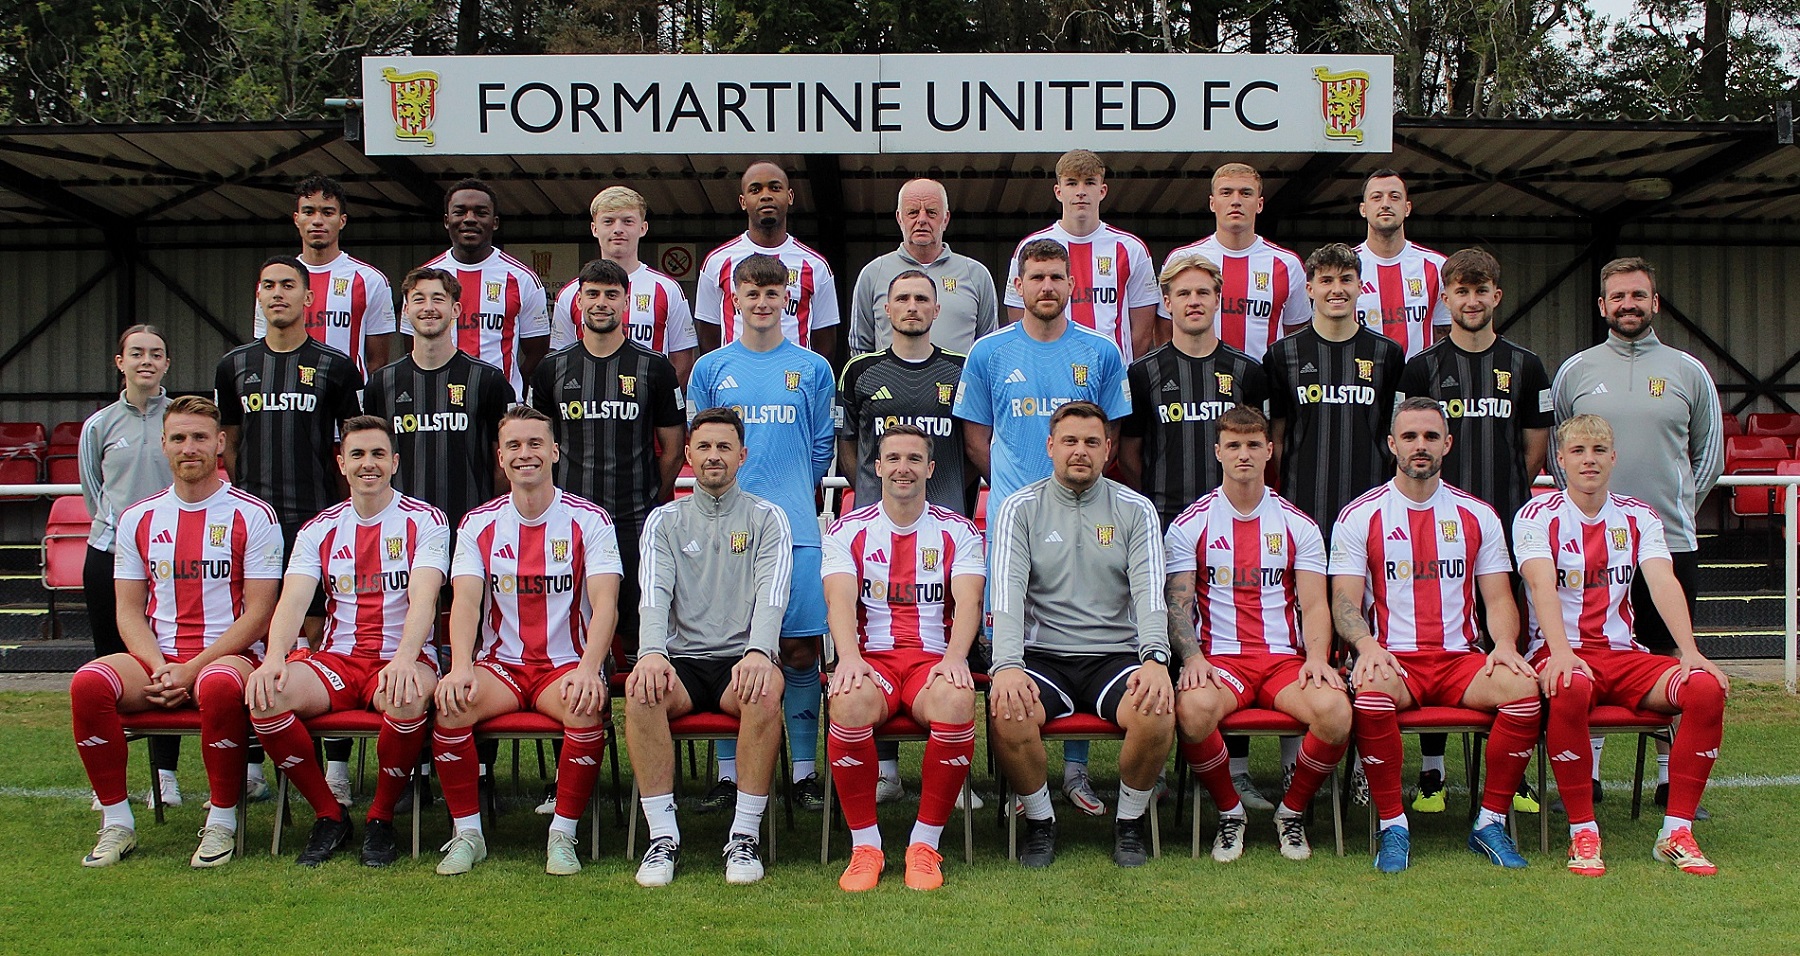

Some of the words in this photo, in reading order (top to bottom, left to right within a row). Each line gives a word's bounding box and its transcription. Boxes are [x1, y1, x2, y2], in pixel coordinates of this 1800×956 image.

[478, 81, 902, 133] FORMARTINE
[926, 81, 1177, 132] UNITED
[1203, 80, 1280, 131] FC
[1070, 287, 1117, 304] LLSTUD
[1221, 297, 1271, 317] LLSTUD
[456, 312, 504, 330] LLSTUD
[241, 392, 317, 413] ROLLSTUD
[1297, 384, 1375, 405] ROLLSTUD
[558, 400, 640, 420] ROLLSTUD
[1011, 397, 1084, 417] ROLLS
[1438, 398, 1512, 419] ROLLSTUD
[393, 412, 469, 434] ROLLSTUD
[150, 559, 231, 580] ROLLSTUD
[1207, 565, 1286, 587] ROLLSTUD
[1387, 558, 1464, 581] ROLLSTUD
[1557, 564, 1632, 589] ROLLSTUD
[330, 570, 409, 594] ROLLSTUD
[491, 573, 573, 594] ROLLSTUD
[862, 578, 944, 603] ROLLSTUD
